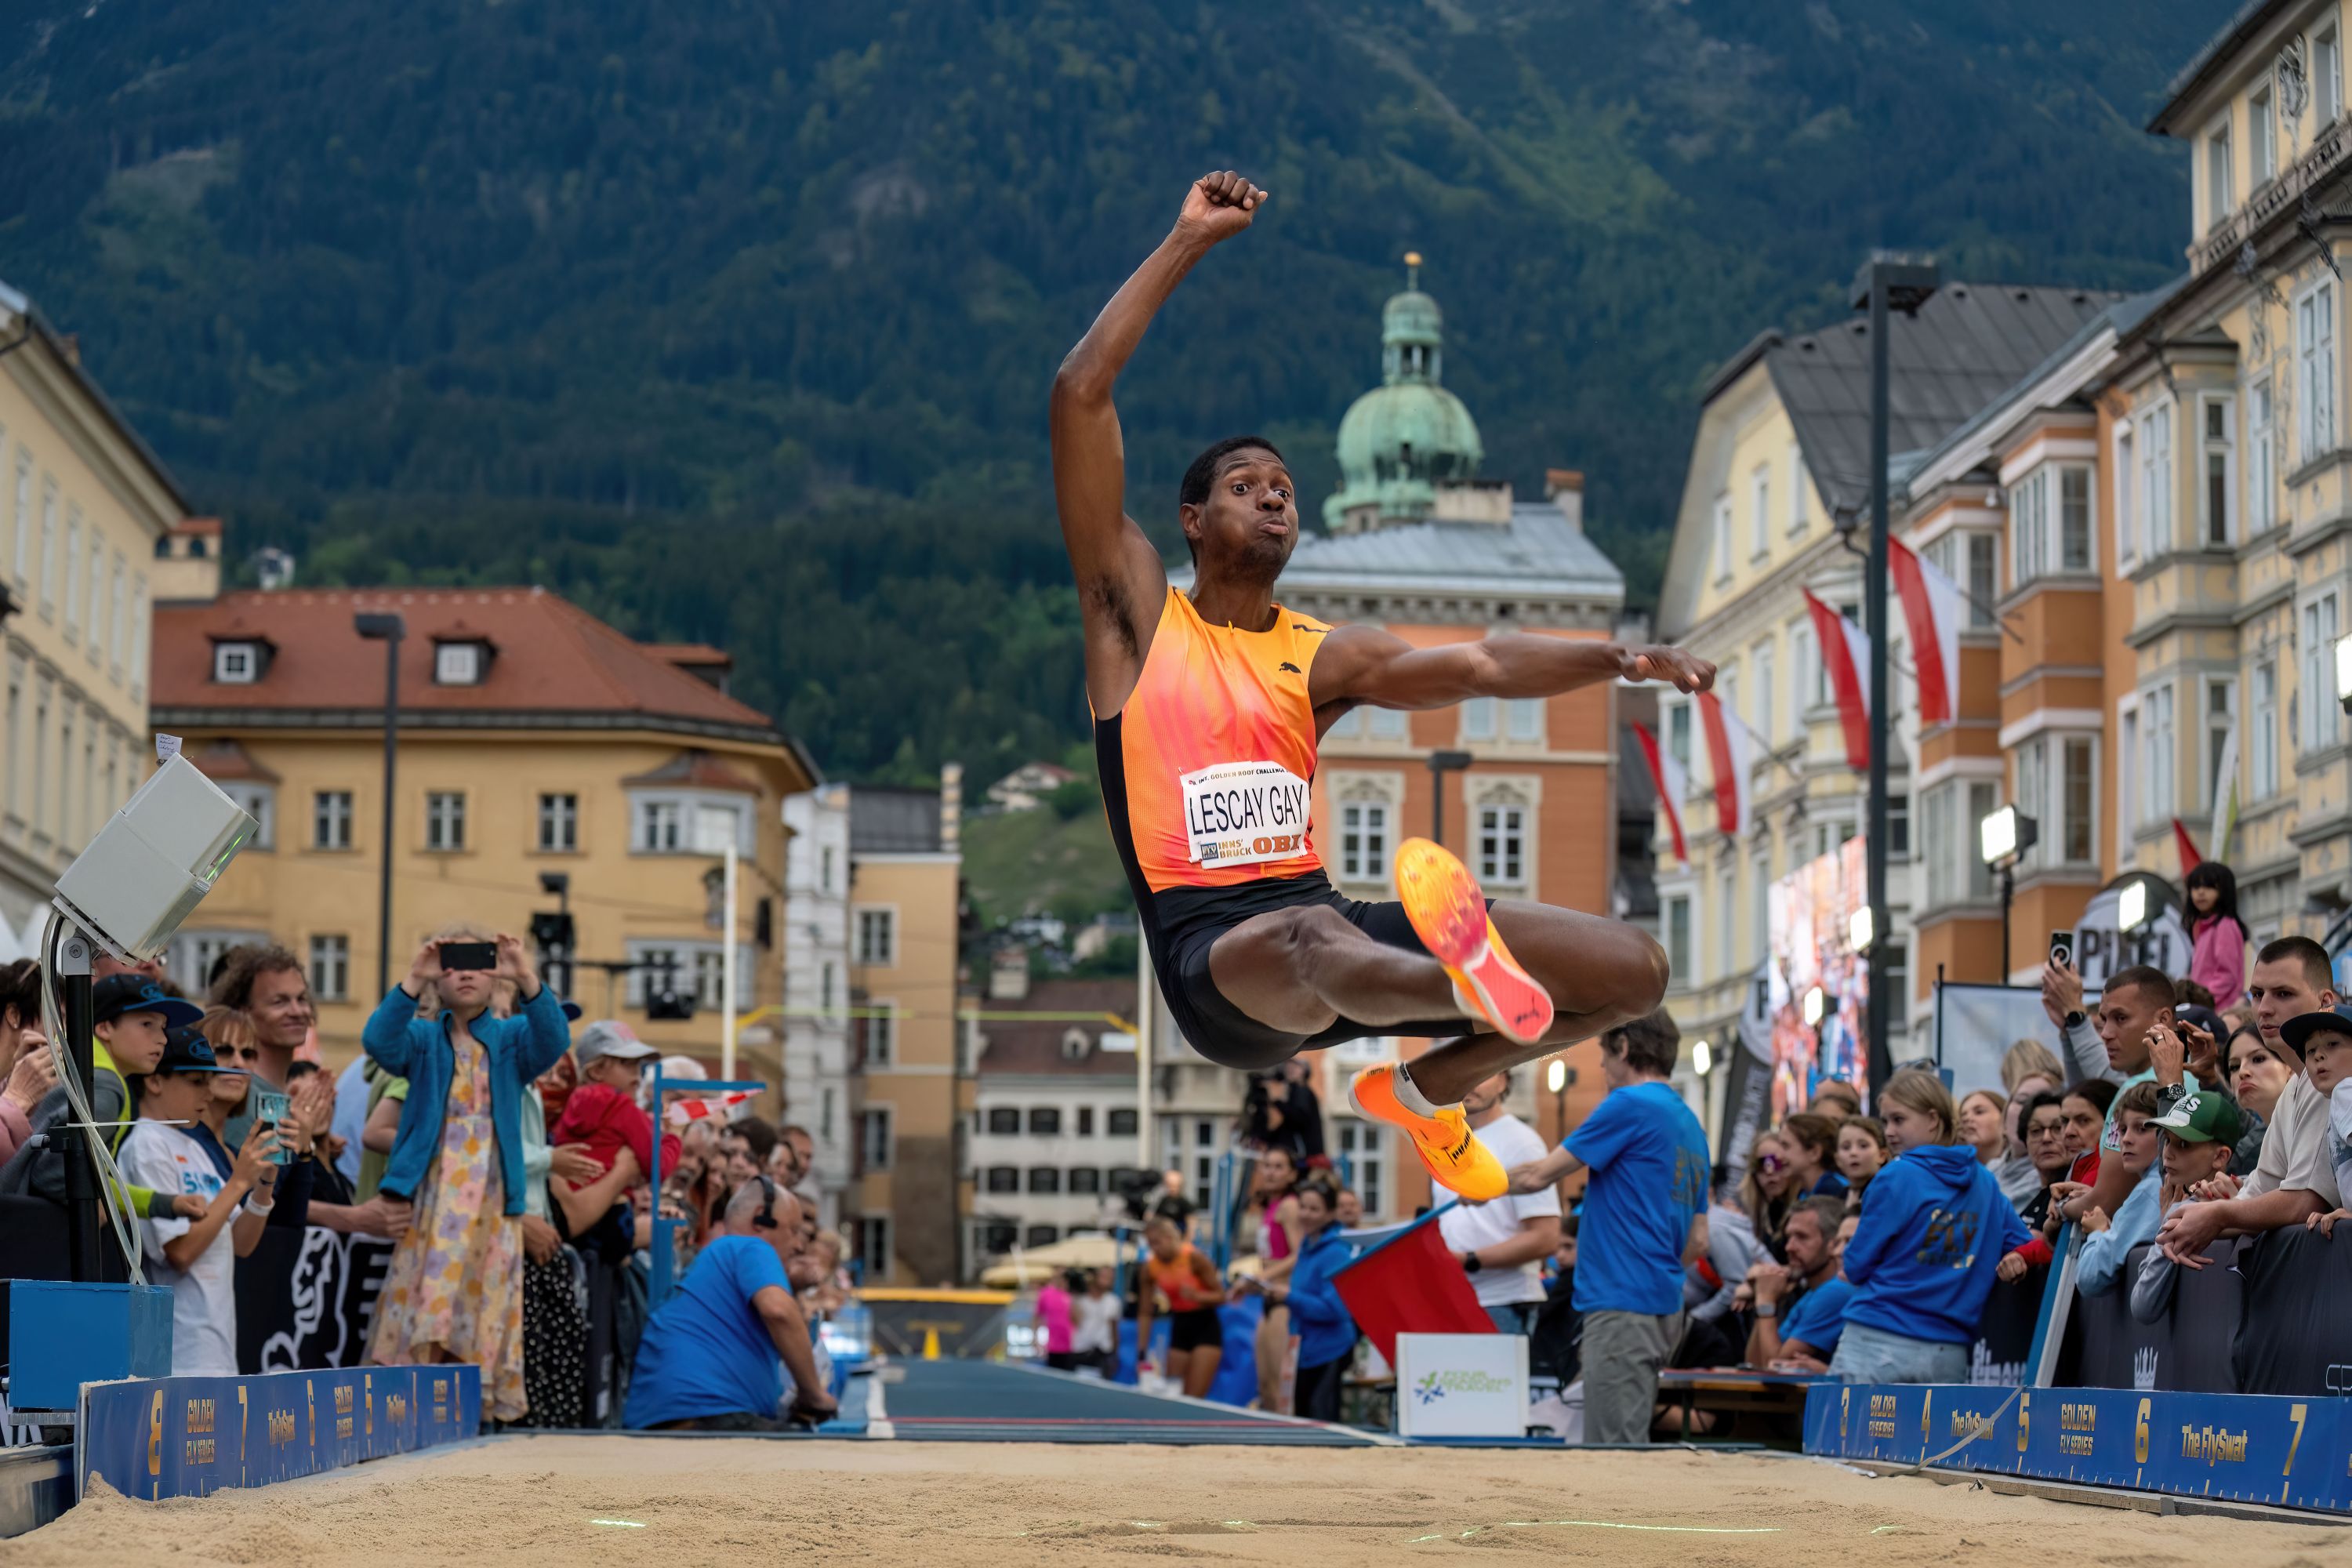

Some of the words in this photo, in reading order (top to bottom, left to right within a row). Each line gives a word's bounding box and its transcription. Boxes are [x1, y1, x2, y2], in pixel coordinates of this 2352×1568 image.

[1210, 771, 1236, 780] GOLDEN
[1238, 769, 1254, 778] ROOF
[1189, 787, 1265, 835] LESCAY
[1269, 784, 1303, 826] GAY
[1220, 848, 1252, 858] BRUCK
[1252, 833, 1301, 855] OBI
[147, 1389, 163, 1475] 8
[187, 1399, 215, 1434] GOLDEN
[238, 1385, 248, 1461] 7
[1921, 1388, 1933, 1443] 4
[2017, 1392, 2031, 1452] 5
[2061, 1403, 2096, 1432] GOLDEN
[2135, 1398, 2151, 1464] 6
[2060, 1434, 2071, 1454] FLY
[2071, 1436, 2093, 1456] SERIES
[2181, 1423, 2201, 1459] The
[2201, 1425, 2248, 1467] FlySwat
[2282, 1403, 2308, 1476] 7
